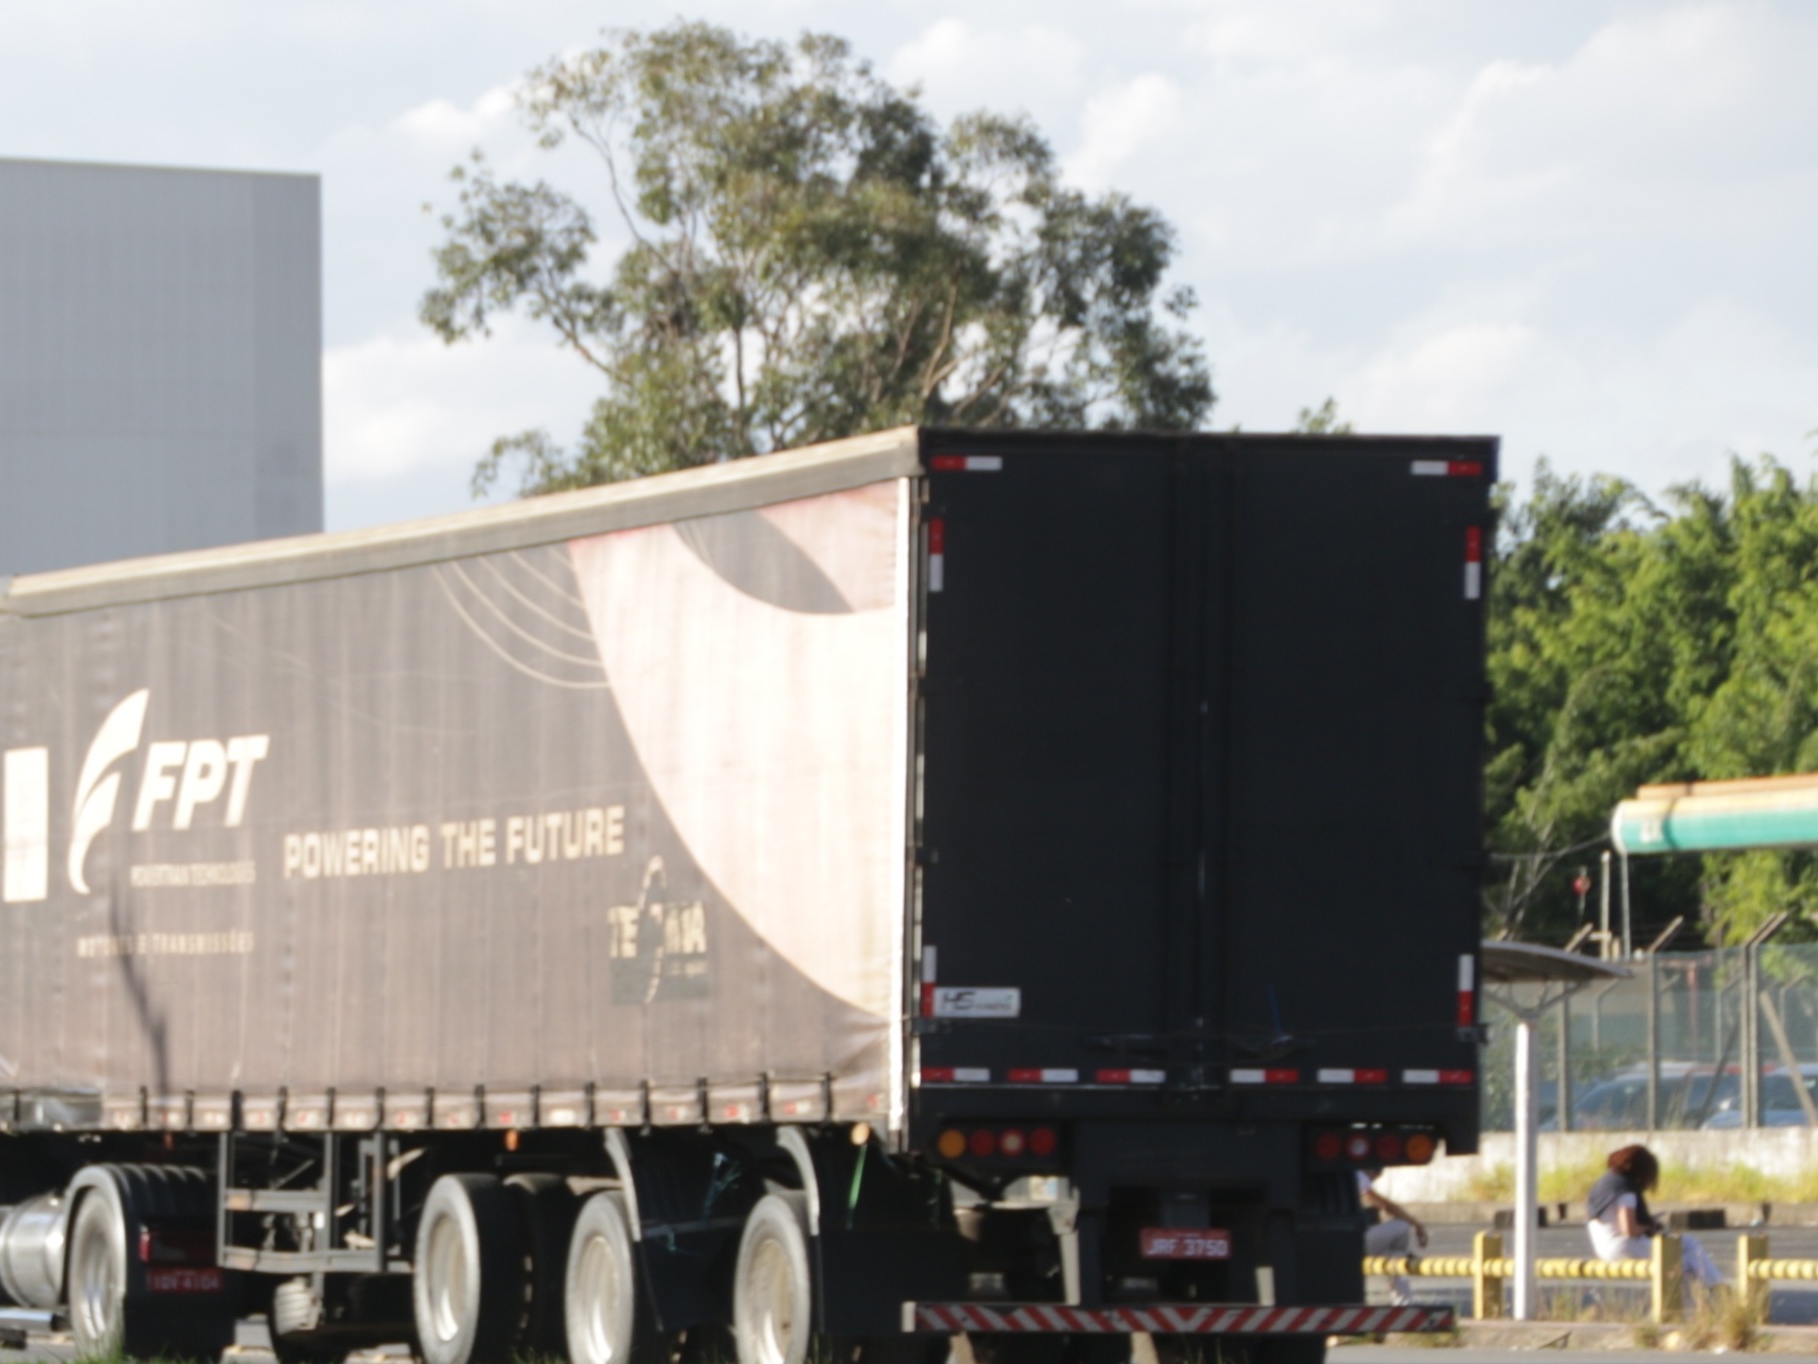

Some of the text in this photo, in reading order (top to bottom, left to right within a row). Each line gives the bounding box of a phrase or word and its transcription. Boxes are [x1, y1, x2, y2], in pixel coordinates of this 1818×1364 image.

[133, 734, 270, 832] FPT
[284, 805, 624, 879] POWERING THE FUTURE
[1184, 1238, 1229, 1257] 3750
